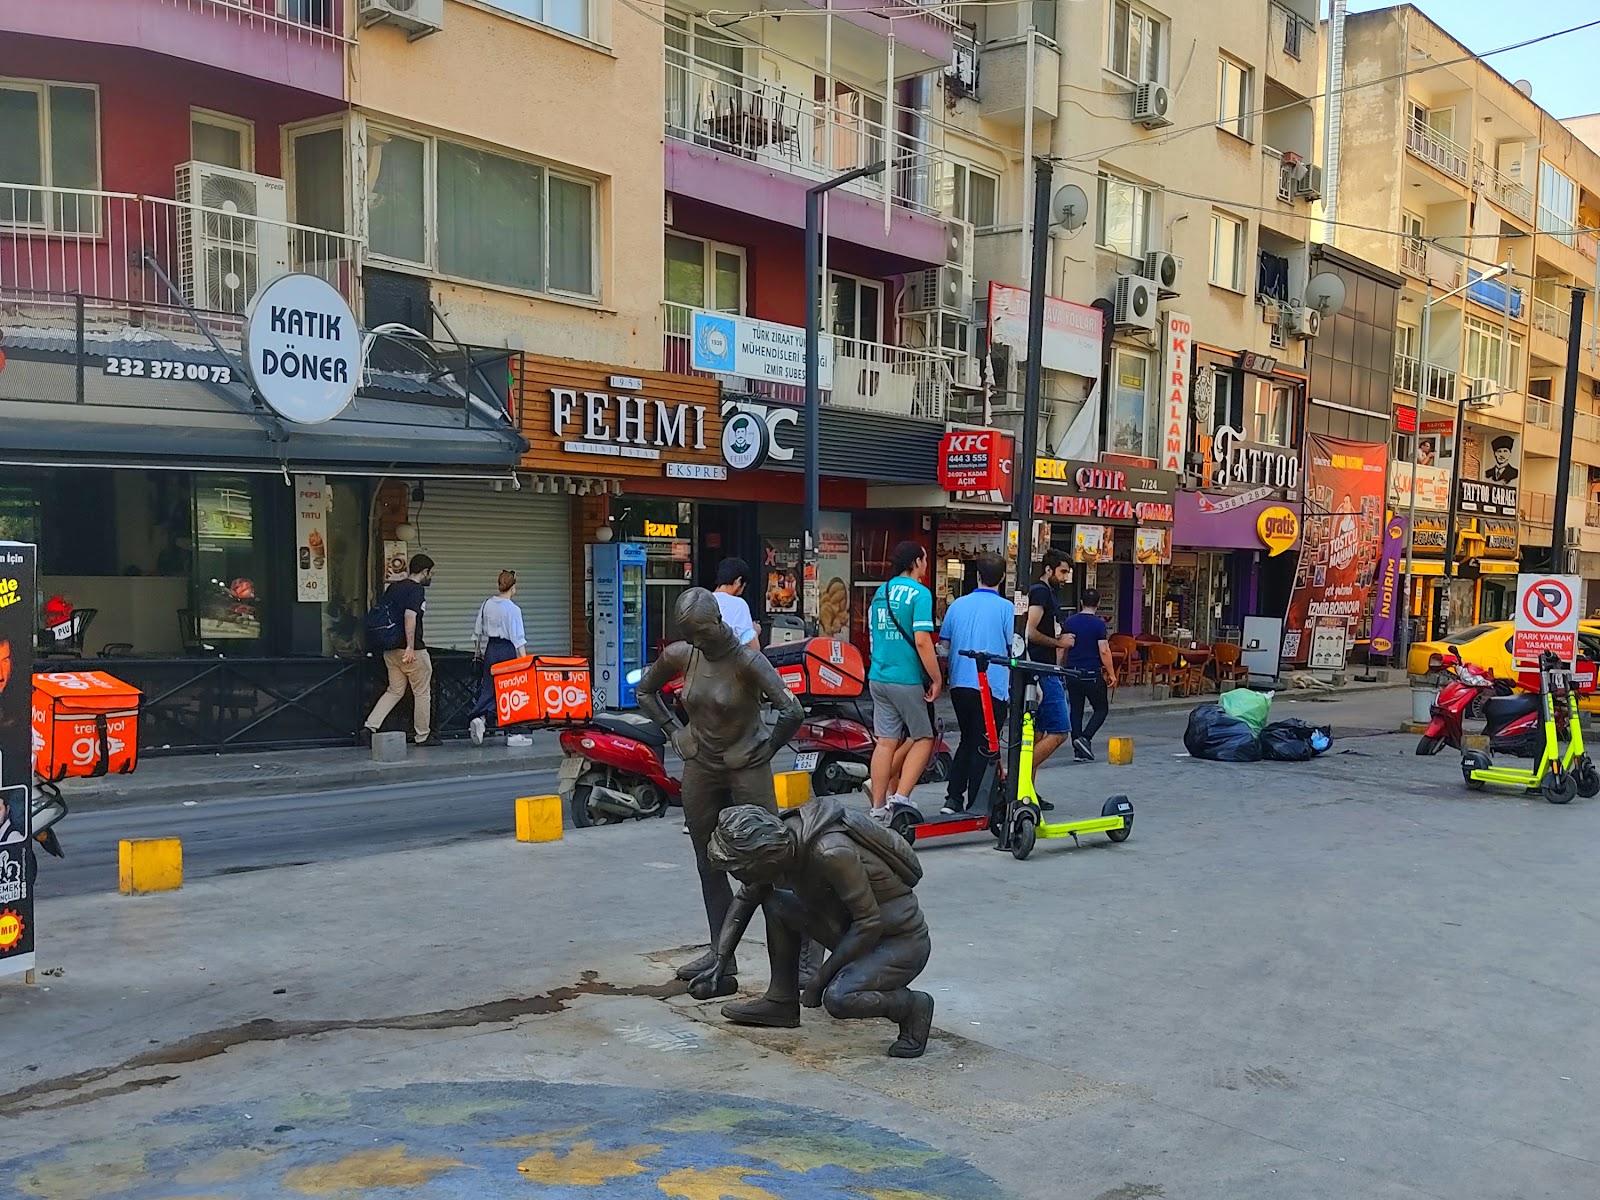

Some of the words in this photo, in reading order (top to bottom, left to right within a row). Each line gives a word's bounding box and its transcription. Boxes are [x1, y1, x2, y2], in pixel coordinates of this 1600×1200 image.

[271, 305, 341, 341] KATIK
[1065, 309, 1097, 333] YOLLARI
[1171, 319, 1190, 334] OTO
[753, 326, 770, 341] TÜRK
[772, 330, 793, 346] ZİRAAT
[742, 341, 800, 363] MÜHENDİSLERİ
[106, 357, 144, 376] 232
[151, 360, 184, 380] 373
[187, 364, 209, 381] 00
[211, 366, 231, 384] 73
[262, 343, 348, 384] DÖNER
[764, 362, 783, 376] İZMİR
[947, 434, 990, 452] KFC
[949, 455, 963, 463] 444
[965, 455, 970, 463] 3
[972, 454, 987, 462] 555
[1214, 425, 1298, 490] TATTOO
[668, 465, 726, 479] EKSPRES
[958, 478, 976, 487] AÇIK
[1141, 479, 1157, 490] 7/24
[1219, 500, 1237, 511] 388
[1248, 488, 1266, 500] 288
[1462, 483, 1490, 504] TATTOO
[1265, 514, 1295, 539] gratis
[7, 552, 23, 565] İçin
[1379, 558, 1395, 619] İNDİRİM
[1308, 598, 1329, 616] İZMİR
[1329, 600, 1360, 615] BORNOVA
[1525, 641, 1563, 649] YASAKTIR
[499, 673, 528, 689] trendyol
[500, 690, 530, 721] go
[544, 685, 587, 714] go
